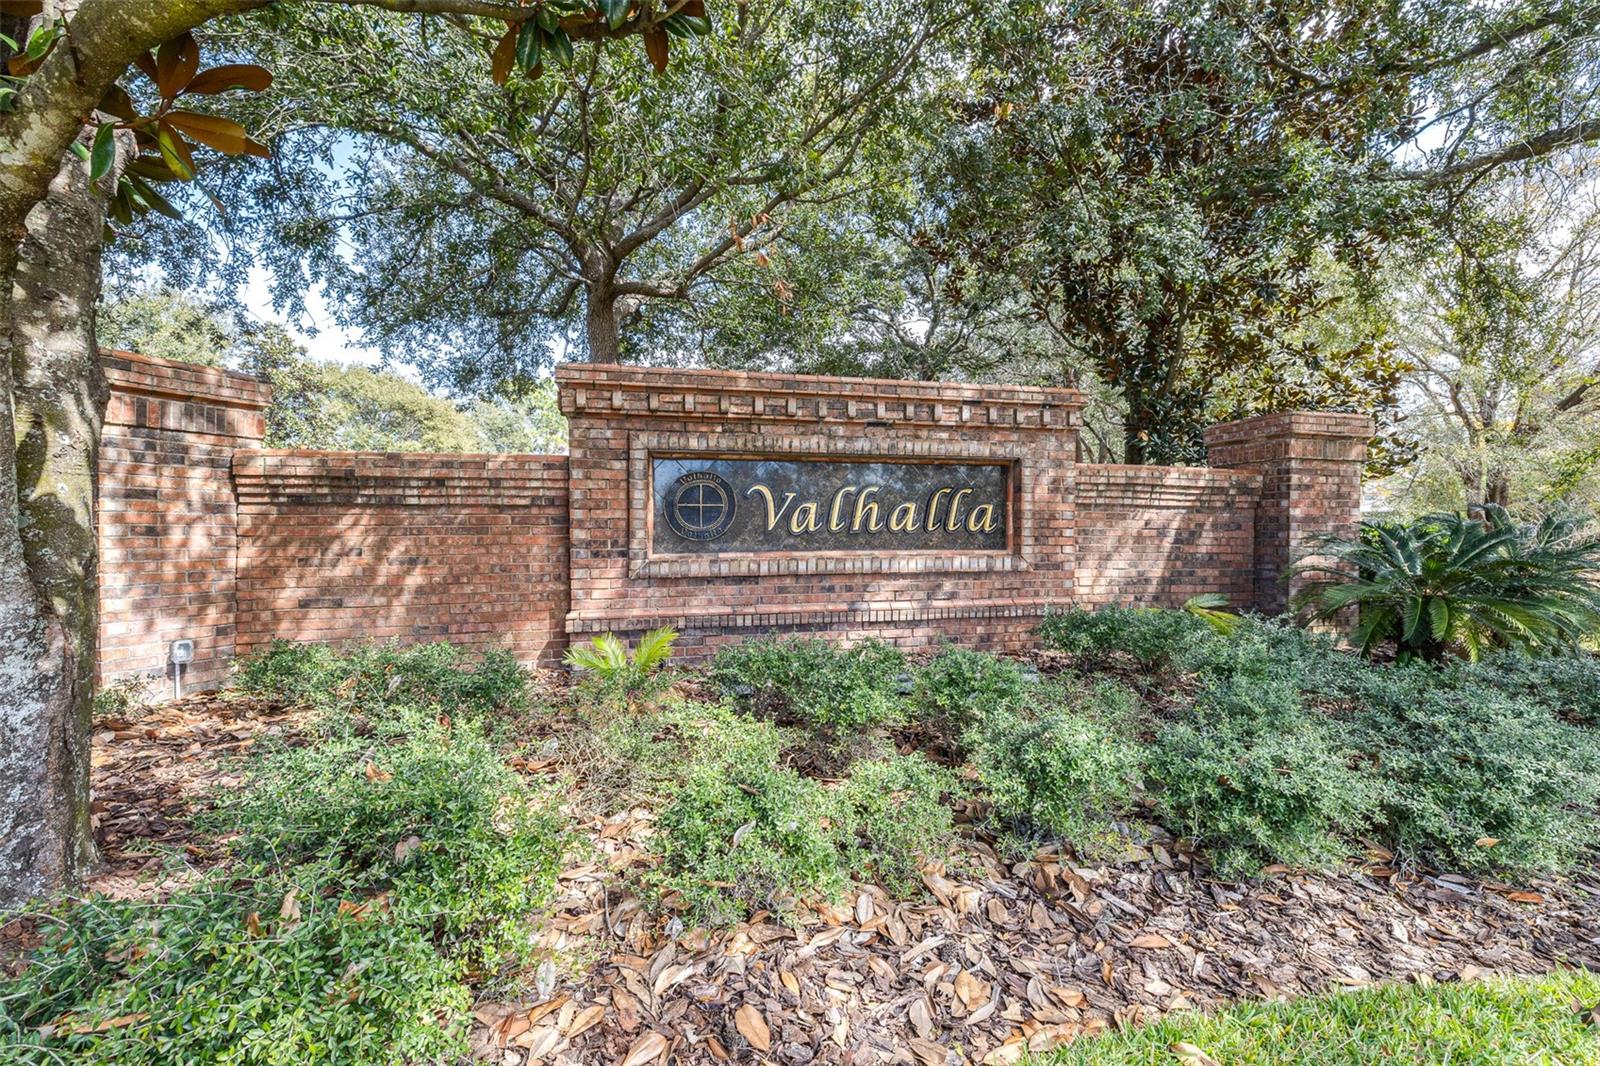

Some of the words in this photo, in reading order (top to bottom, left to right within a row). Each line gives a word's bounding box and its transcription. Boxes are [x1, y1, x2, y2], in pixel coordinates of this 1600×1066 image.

[680, 472, 722, 484] Valhalla
[747, 484, 997, 532] Valhalla
[681, 527, 724, 539] Valalla
